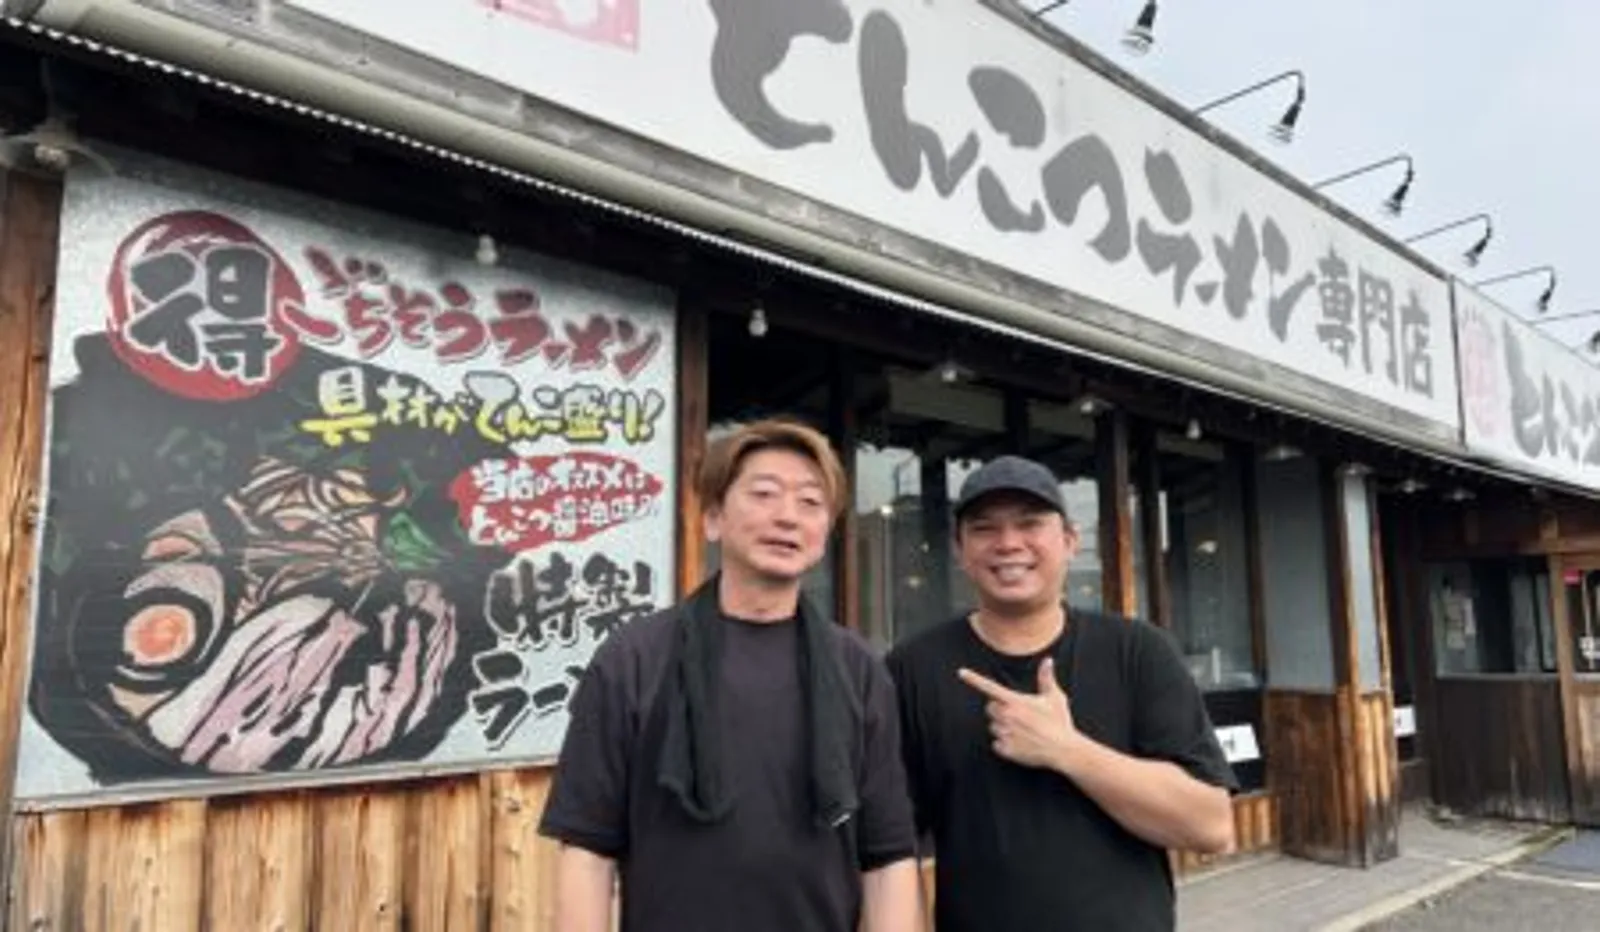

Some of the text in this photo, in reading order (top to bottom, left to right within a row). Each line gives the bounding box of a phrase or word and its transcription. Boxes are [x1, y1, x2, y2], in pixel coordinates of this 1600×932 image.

[708, 0, 1434, 400] とんこつラーメン専門店
[128, 244, 285, 384] 得
[280, 244, 662, 382] ごちそうラーメン
[299, 367, 665, 447] 具材がてんこ盛り!
[468, 648, 585, 750] ラー
